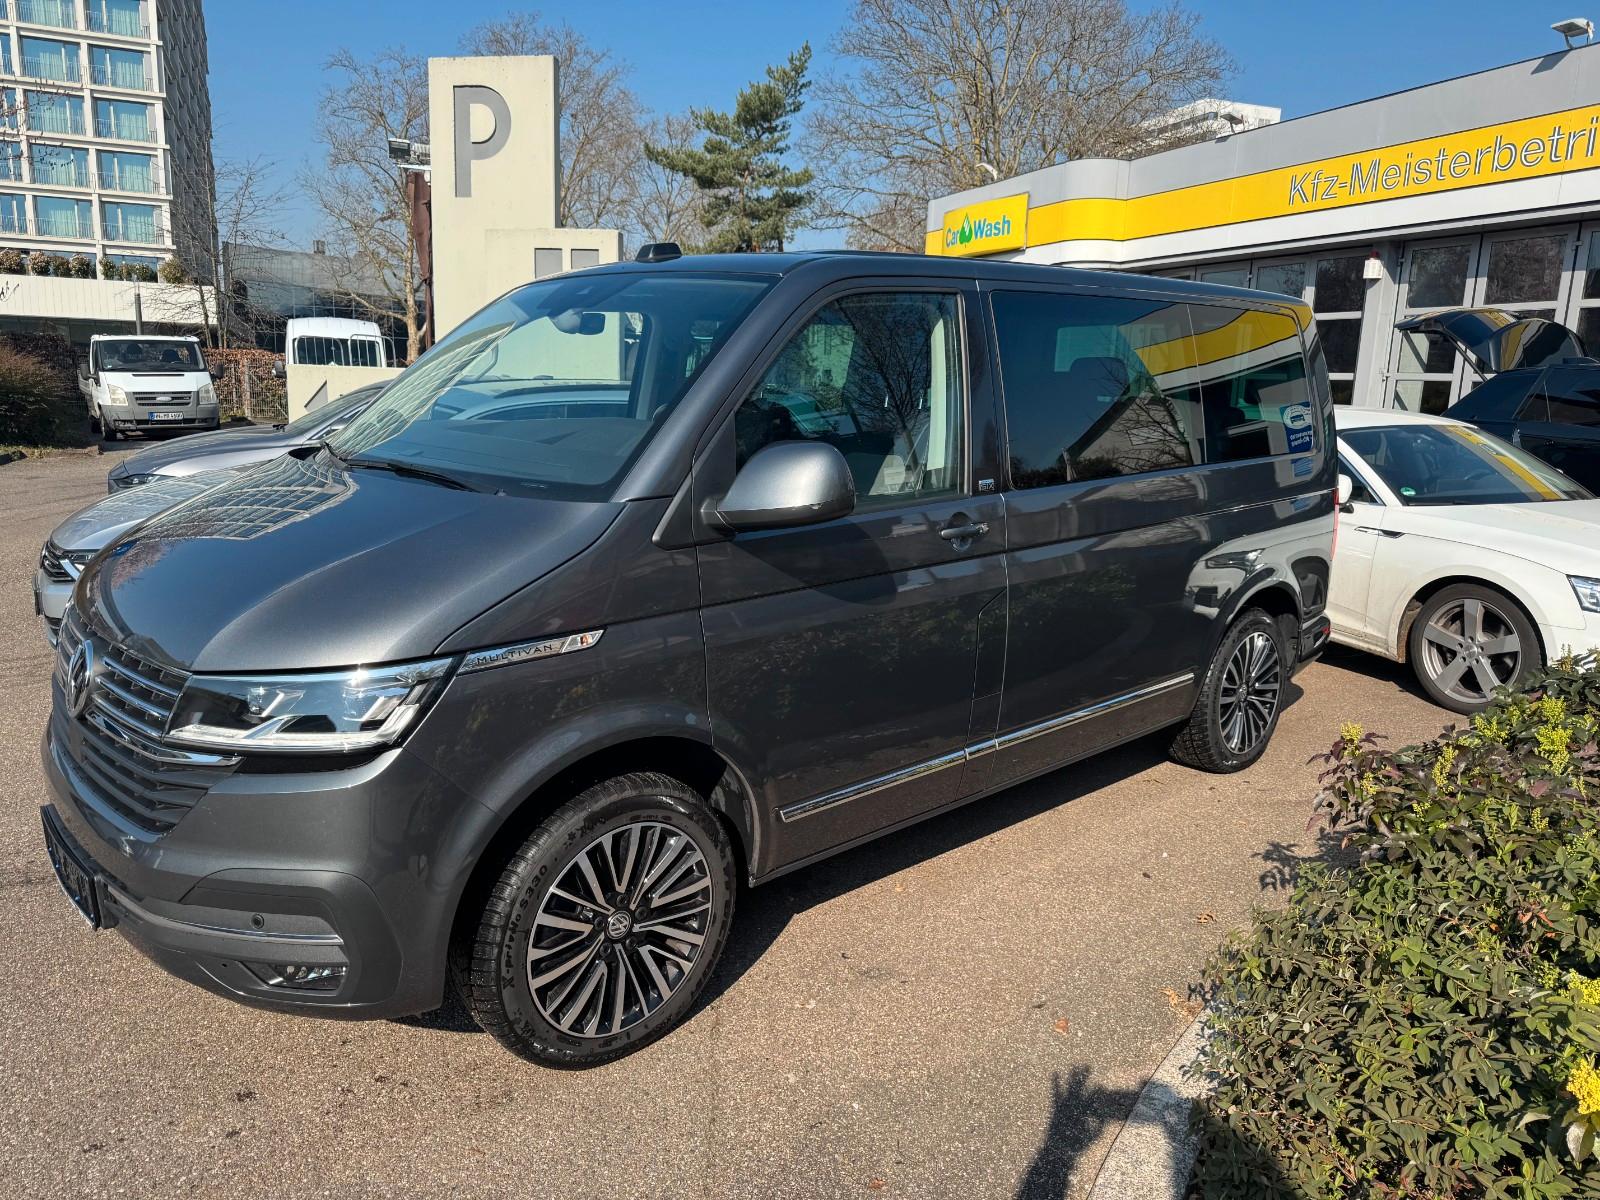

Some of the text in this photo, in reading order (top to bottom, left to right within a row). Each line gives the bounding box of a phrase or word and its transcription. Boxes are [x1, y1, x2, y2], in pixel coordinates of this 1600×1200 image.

[453, 84, 512, 198] P
[1289, 115, 1599, 206] Kfz-Meisterbetri
[946, 215, 1011, 248] Car Wash
[476, 643, 553, 665] MULTIVAN
